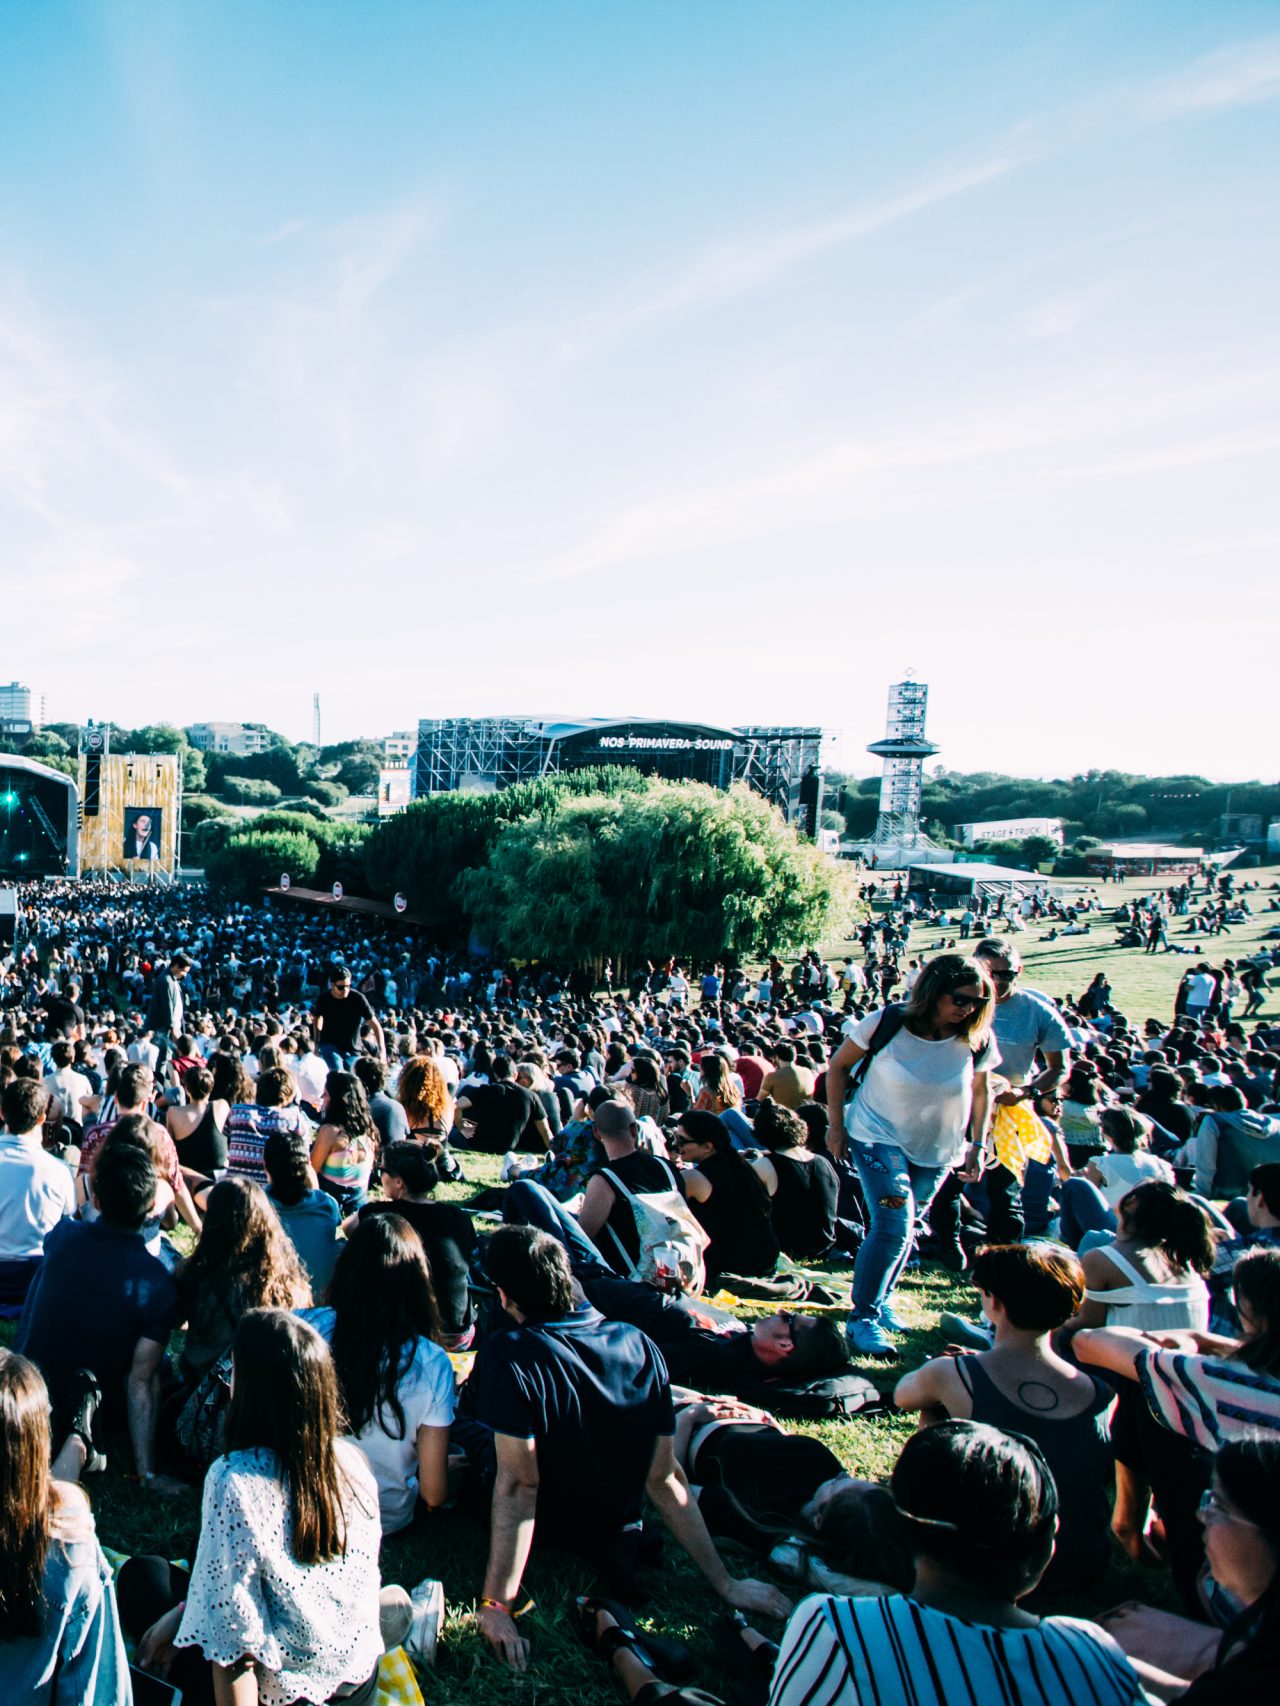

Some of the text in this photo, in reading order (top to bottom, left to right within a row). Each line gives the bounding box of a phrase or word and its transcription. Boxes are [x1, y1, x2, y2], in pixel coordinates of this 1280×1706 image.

[600, 736, 733, 750] NOS PRIMAVERA SOUND
